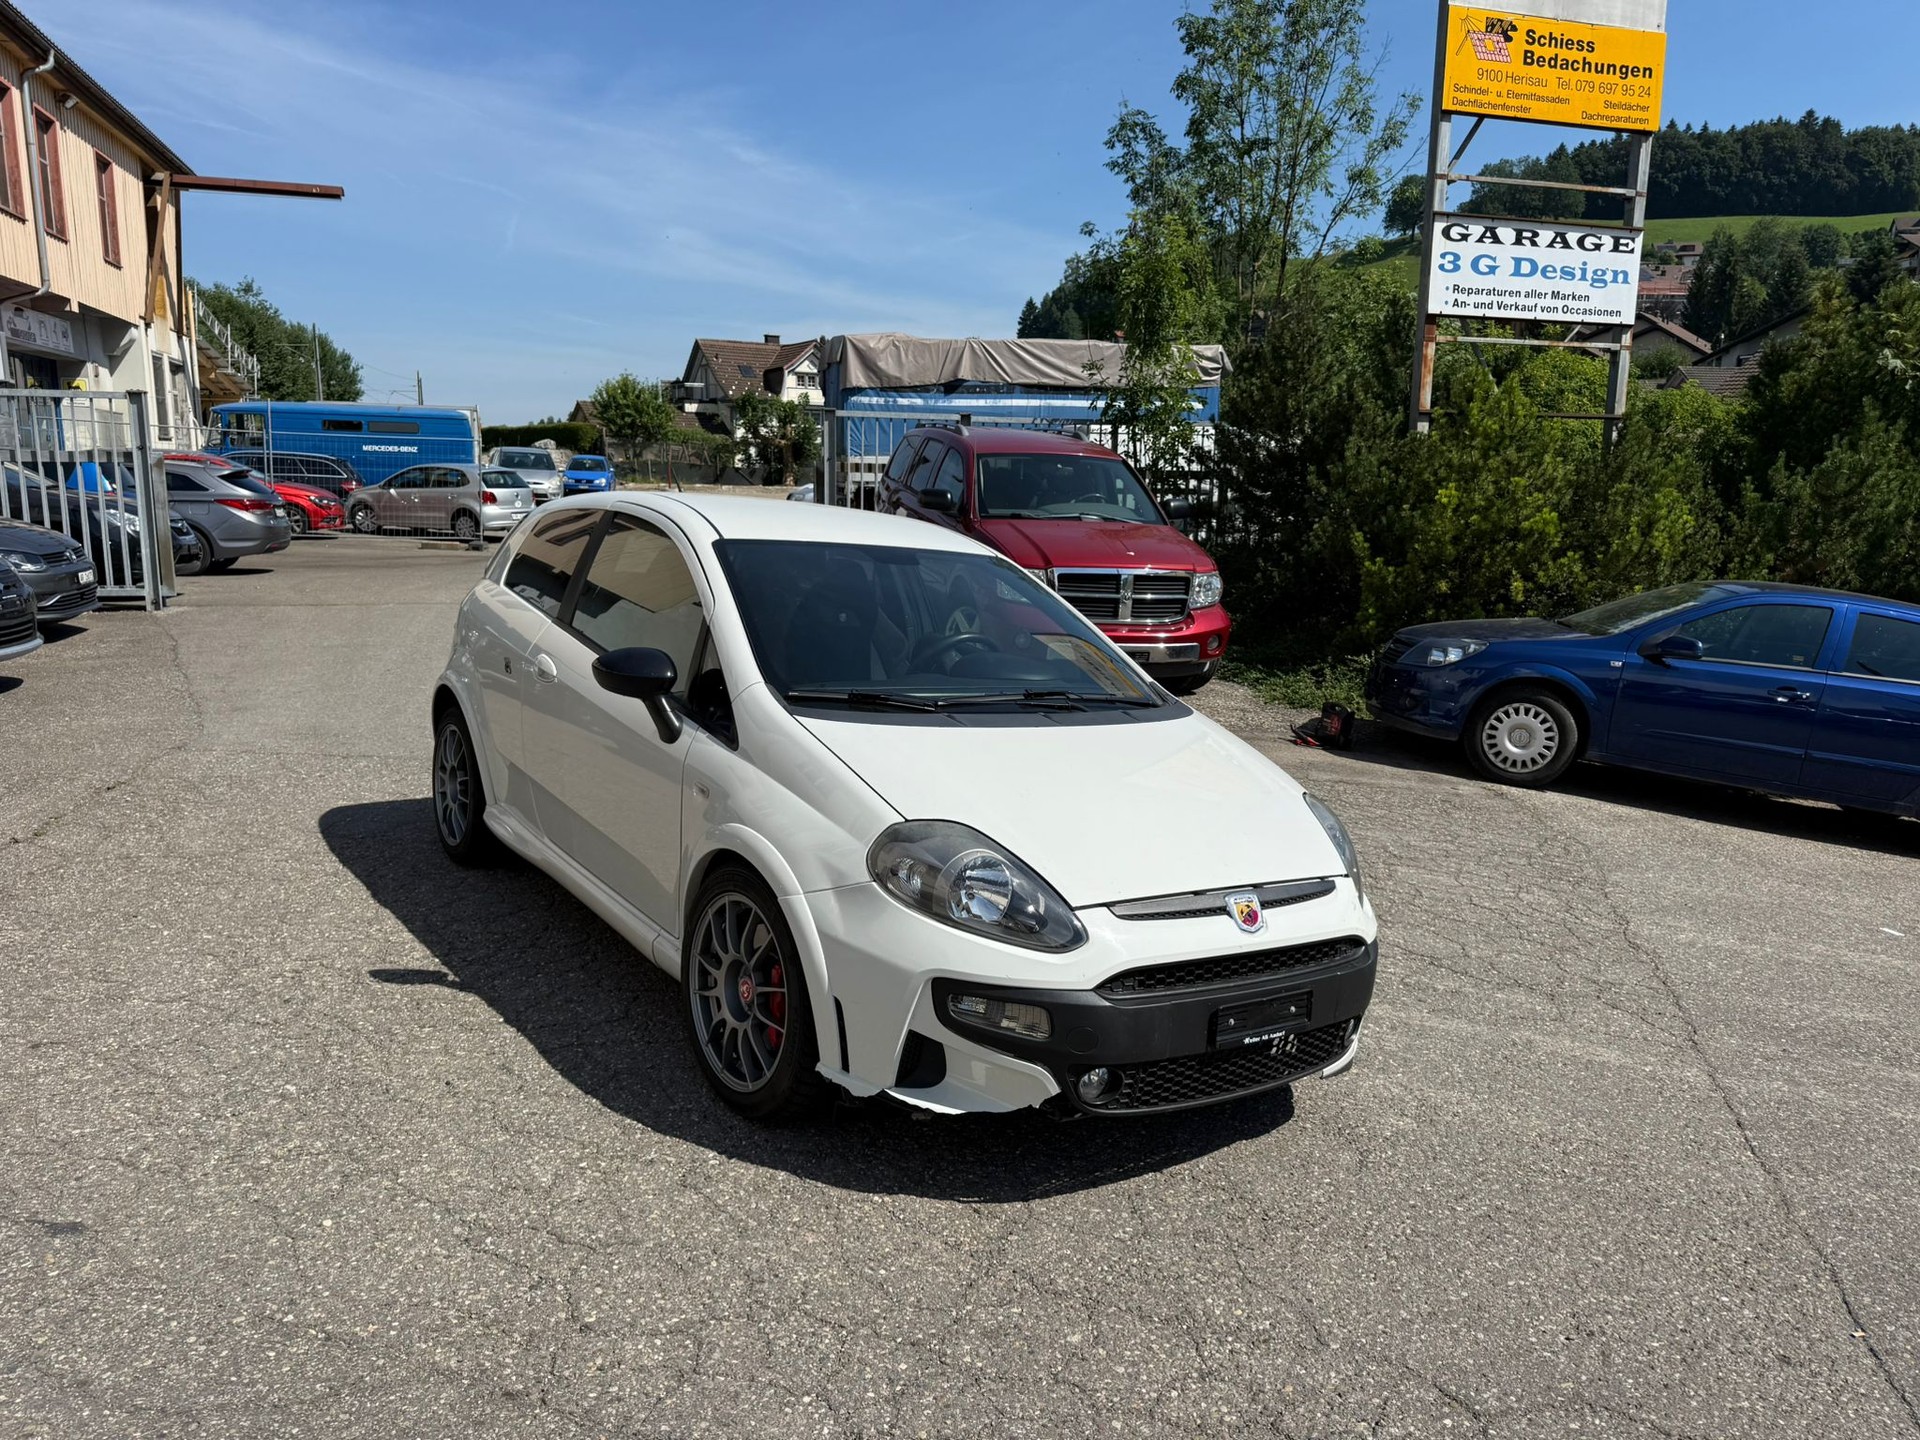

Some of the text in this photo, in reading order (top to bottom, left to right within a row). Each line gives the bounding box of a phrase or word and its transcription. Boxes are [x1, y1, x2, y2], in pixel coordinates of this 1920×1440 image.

[1524, 29, 1596, 53] Schiess
[1522, 52, 1653, 79] Bedachungen
[1477, 67, 1651, 98] 9100 Herisau Tel. 079 697 95 24
[1453, 83, 1570, 105] Schindel- u. Eternitfassaden
[1452, 97, 1532, 114] Dachflächenfenster
[1603, 100, 1650, 113] Steildächer
[1581, 111, 1650, 126] Dachreparaturen
[1441, 222, 1636, 254] GARAGE
[1438, 251, 1631, 289] 3 G Design
[1452, 284, 1590, 302] Reparaturen aller Marken
[1452, 298, 1622, 318] An- und Verkauf von Occasionen
[363, 445, 418, 453] MERCEDES-BENZ
